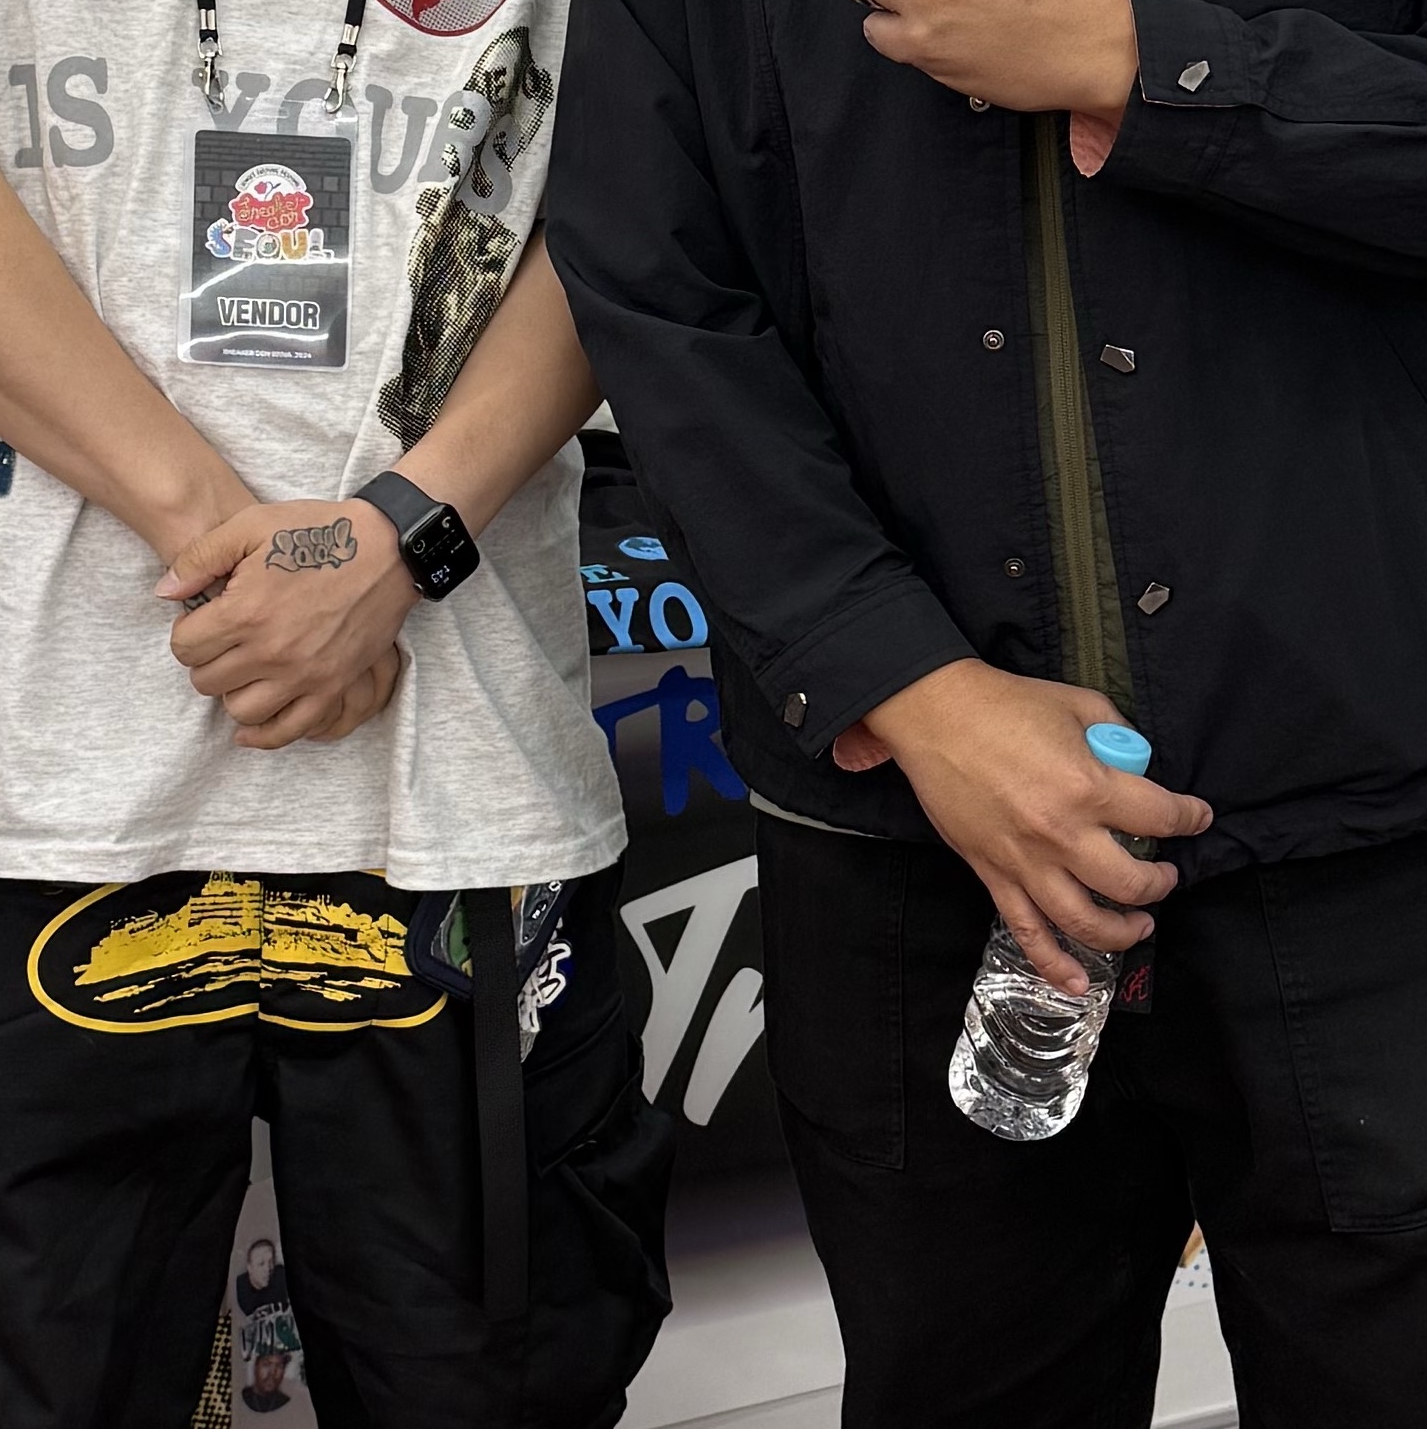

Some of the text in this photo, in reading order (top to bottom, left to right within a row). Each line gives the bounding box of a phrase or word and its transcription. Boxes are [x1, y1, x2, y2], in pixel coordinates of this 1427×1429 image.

[8, 56, 115, 169] IS
[206, 219, 334, 261] SEOUL
[217, 296, 320, 329] VENDOR
